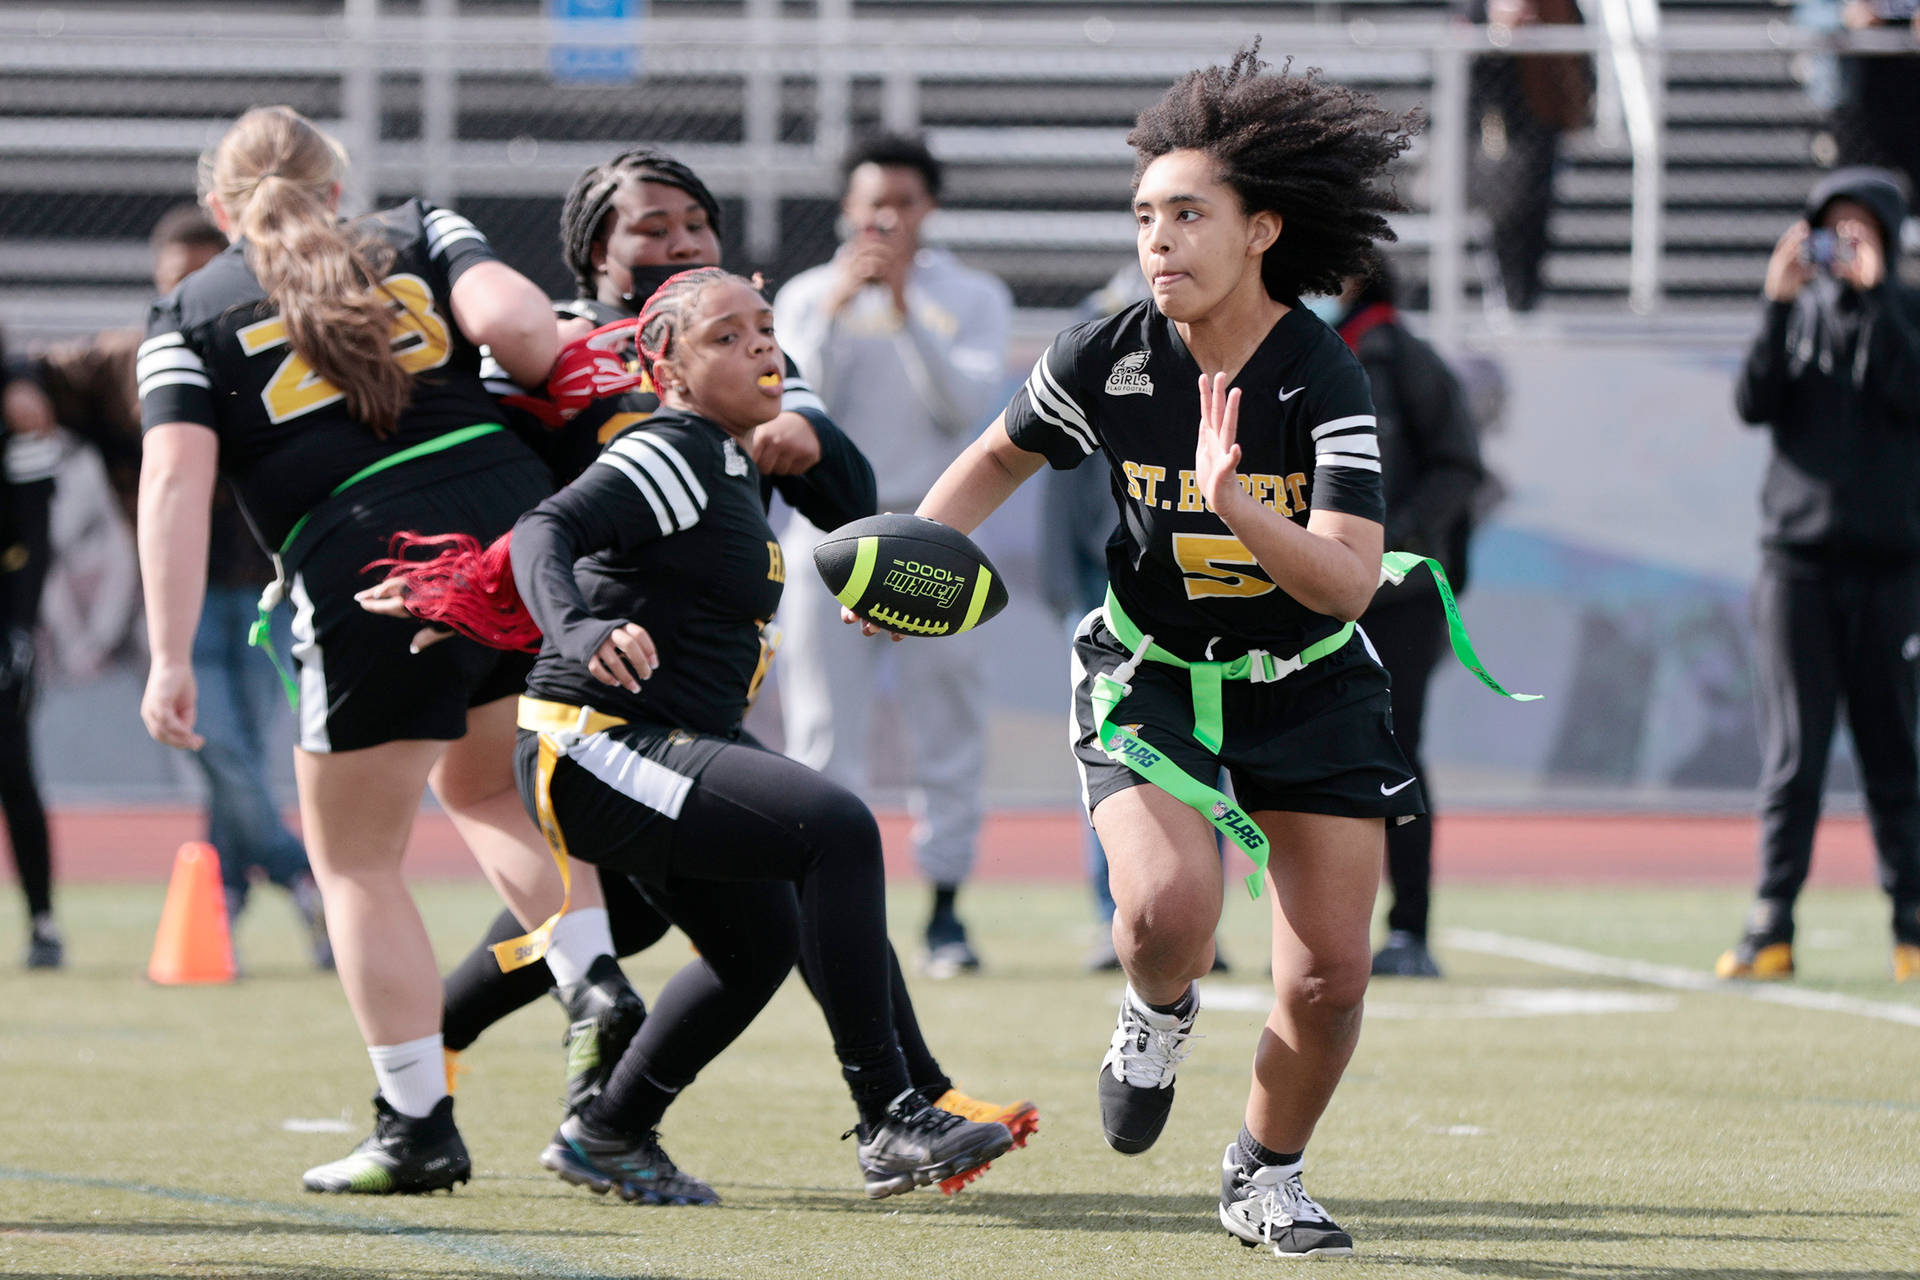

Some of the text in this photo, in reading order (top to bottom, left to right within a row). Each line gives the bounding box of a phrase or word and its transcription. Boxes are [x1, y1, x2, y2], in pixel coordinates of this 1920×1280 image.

[1110, 374, 1148, 386] GIRLS
[1122, 460, 1307, 518] ST. HERT
[1172, 532, 1278, 600] 5
[884, 569, 964, 609] Franklin
[1214, 809, 1265, 850] FLAG
